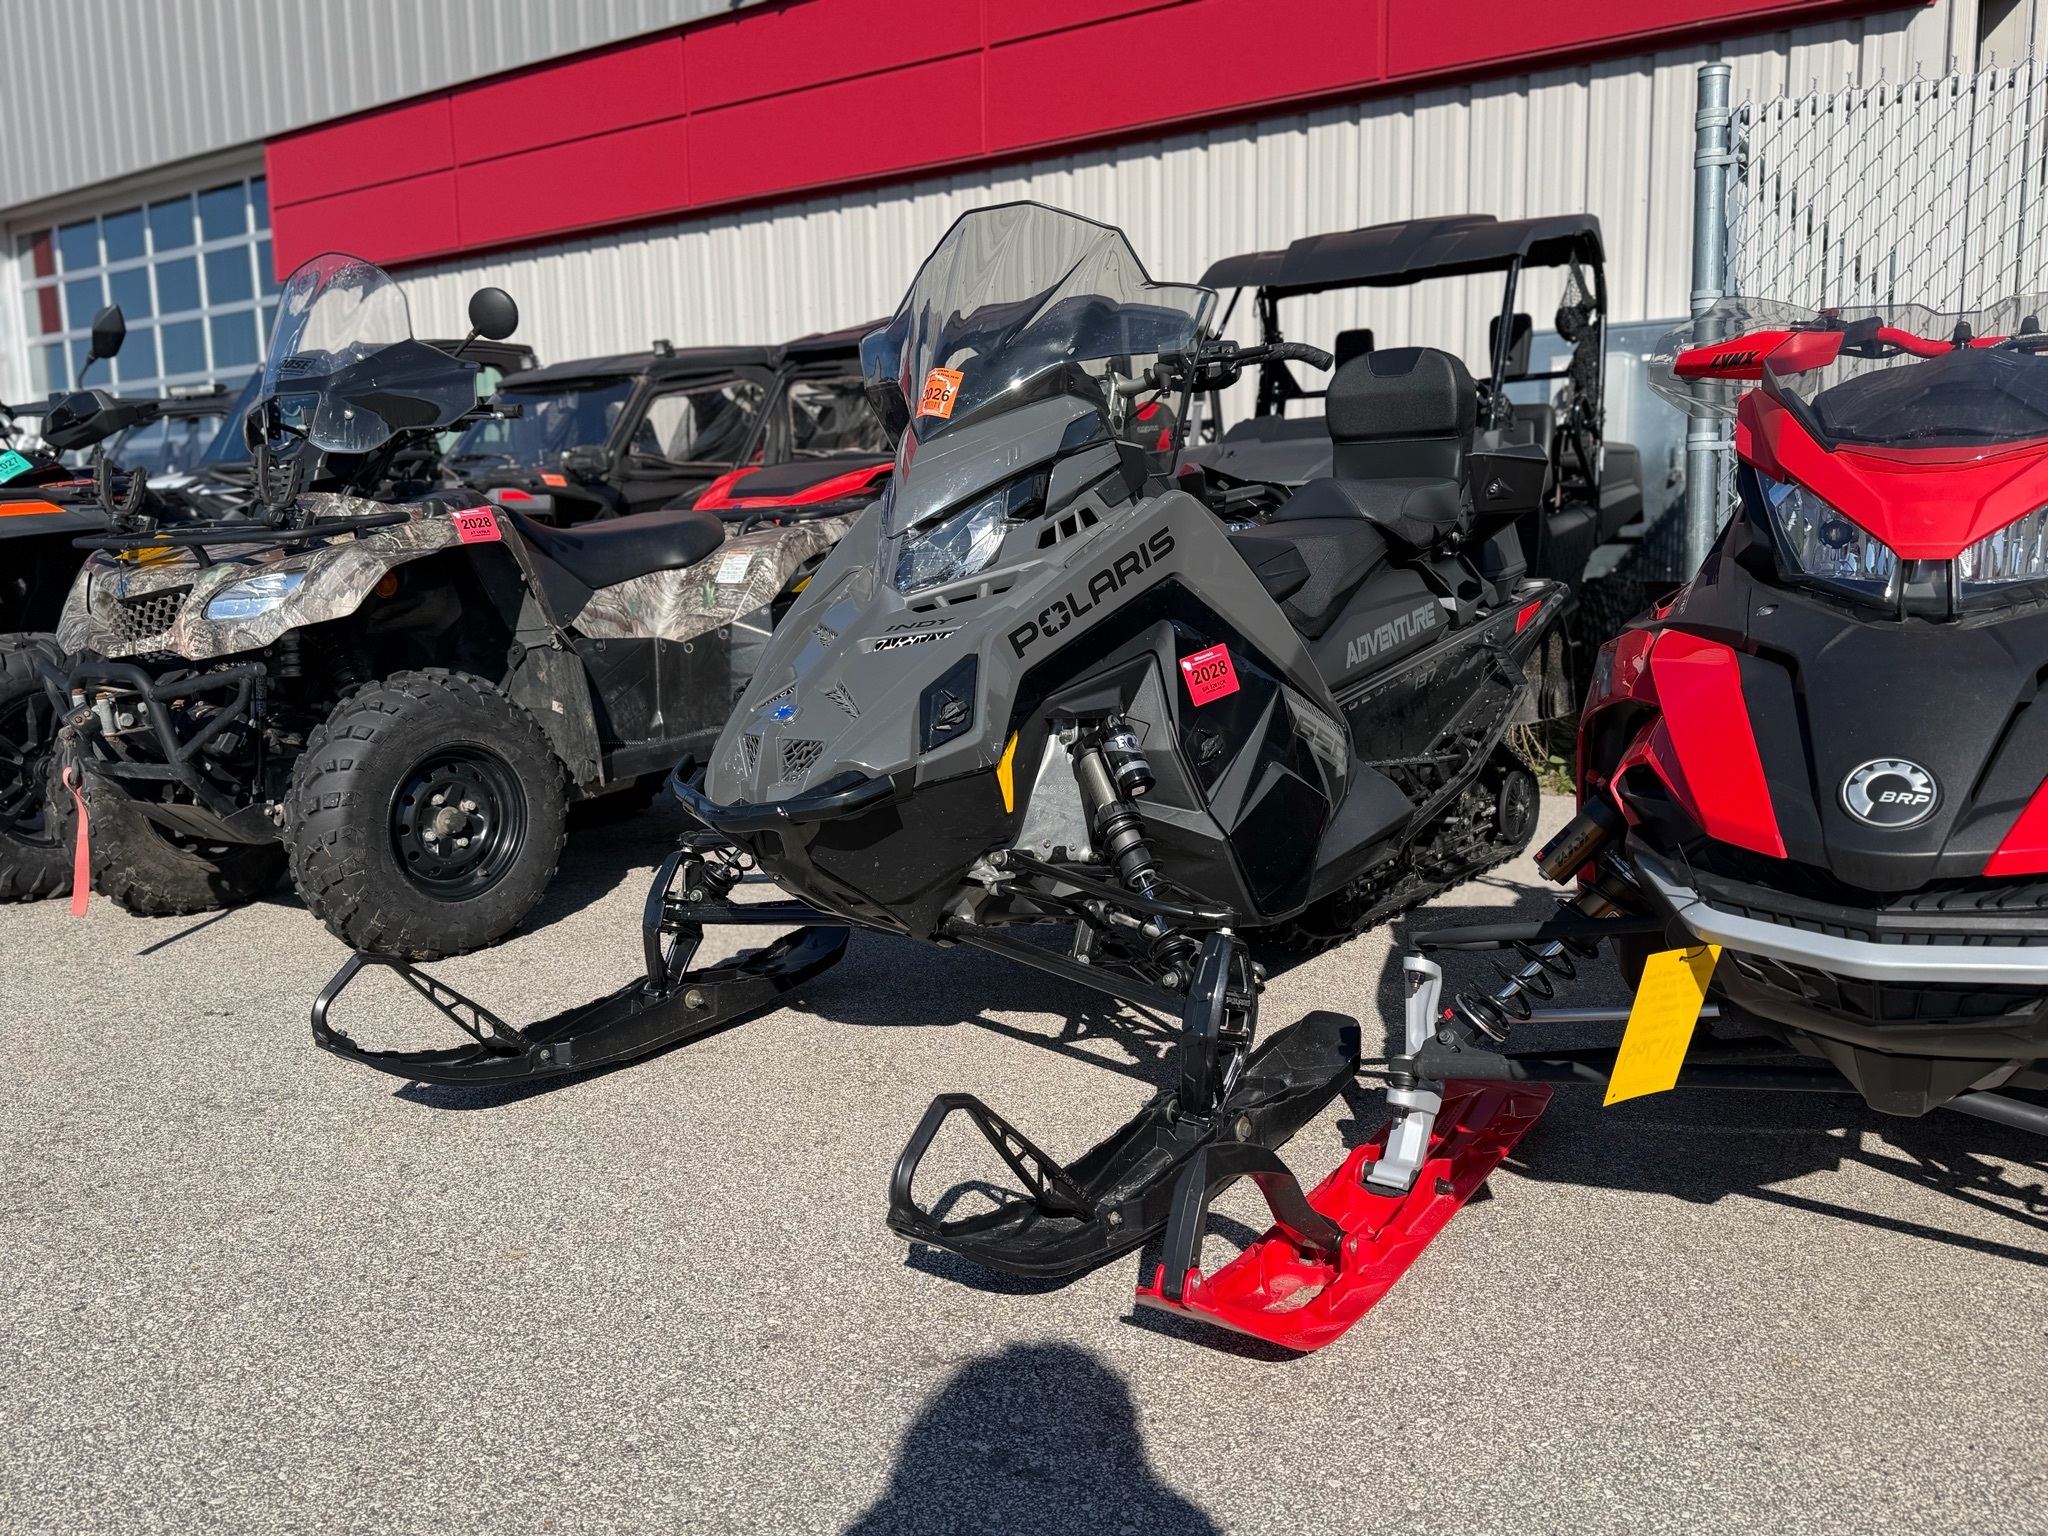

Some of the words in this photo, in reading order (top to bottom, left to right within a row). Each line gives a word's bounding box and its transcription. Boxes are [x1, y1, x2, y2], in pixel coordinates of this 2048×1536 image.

[1710, 350, 1761, 368] LYNX
[460, 516, 492, 530] 2028
[1007, 526, 1175, 659] POLARIS
[885, 617, 956, 632] INDY
[1346, 601, 1436, 669] ADVENTURE
[1191, 660, 1228, 686] 2028
[1414, 667, 1437, 690] 137
[1879, 791, 1930, 805] BRP
